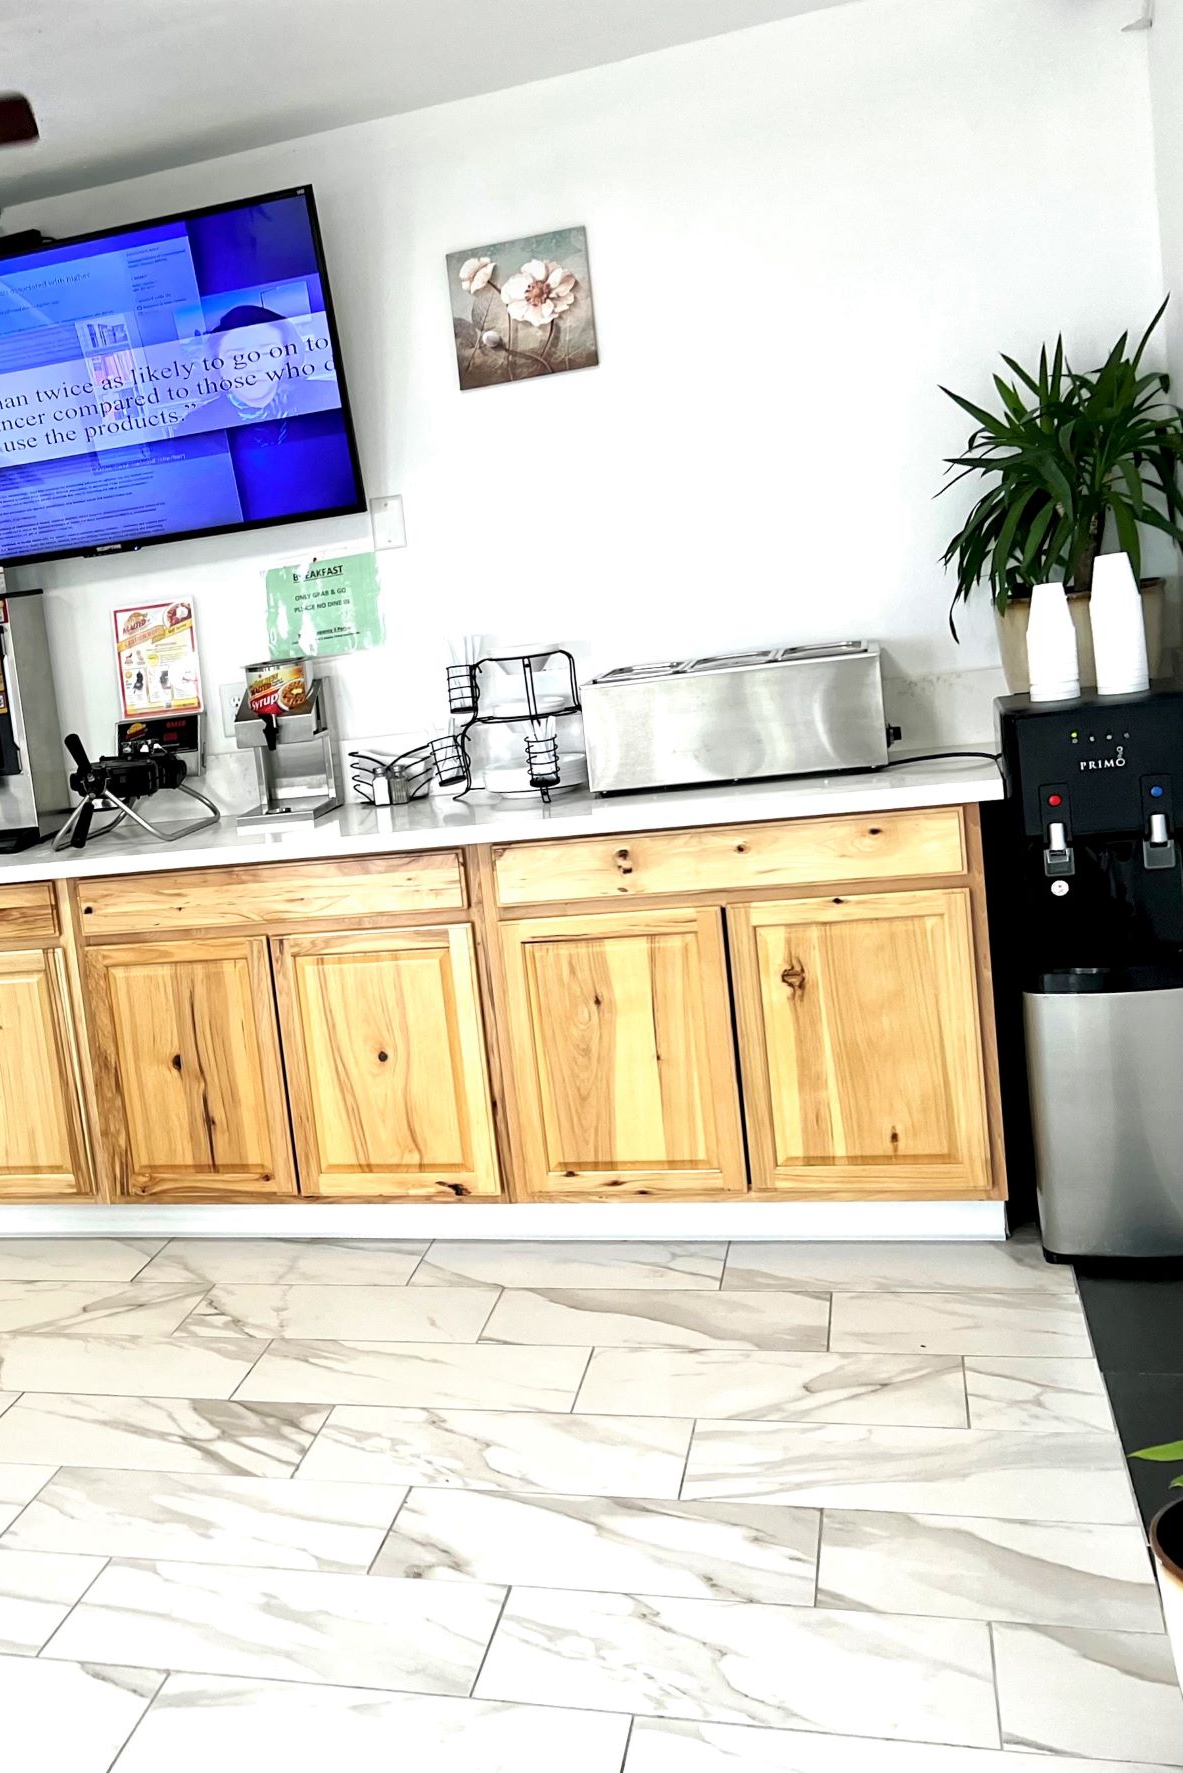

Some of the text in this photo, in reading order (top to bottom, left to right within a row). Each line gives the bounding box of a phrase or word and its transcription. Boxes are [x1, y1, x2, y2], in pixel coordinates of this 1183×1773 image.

[36, 382, 94, 403] twice
[101, 375, 124, 391] as
[130, 360, 194, 386] likely
[203, 356, 224, 371] to
[233, 350, 260, 370] go
[269, 342, 298, 358] on
[307, 336, 329, 351] to
[53, 387, 159, 422] compared
[168, 386, 189, 400] to
[196, 373, 257, 395] those
[266, 361, 315, 382] who
[4, 436, 37, 452] use
[45, 429, 77, 445] the
[293, 565, 343, 581] BEAKFAST
[1080, 758, 1125, 770] PRIMO
